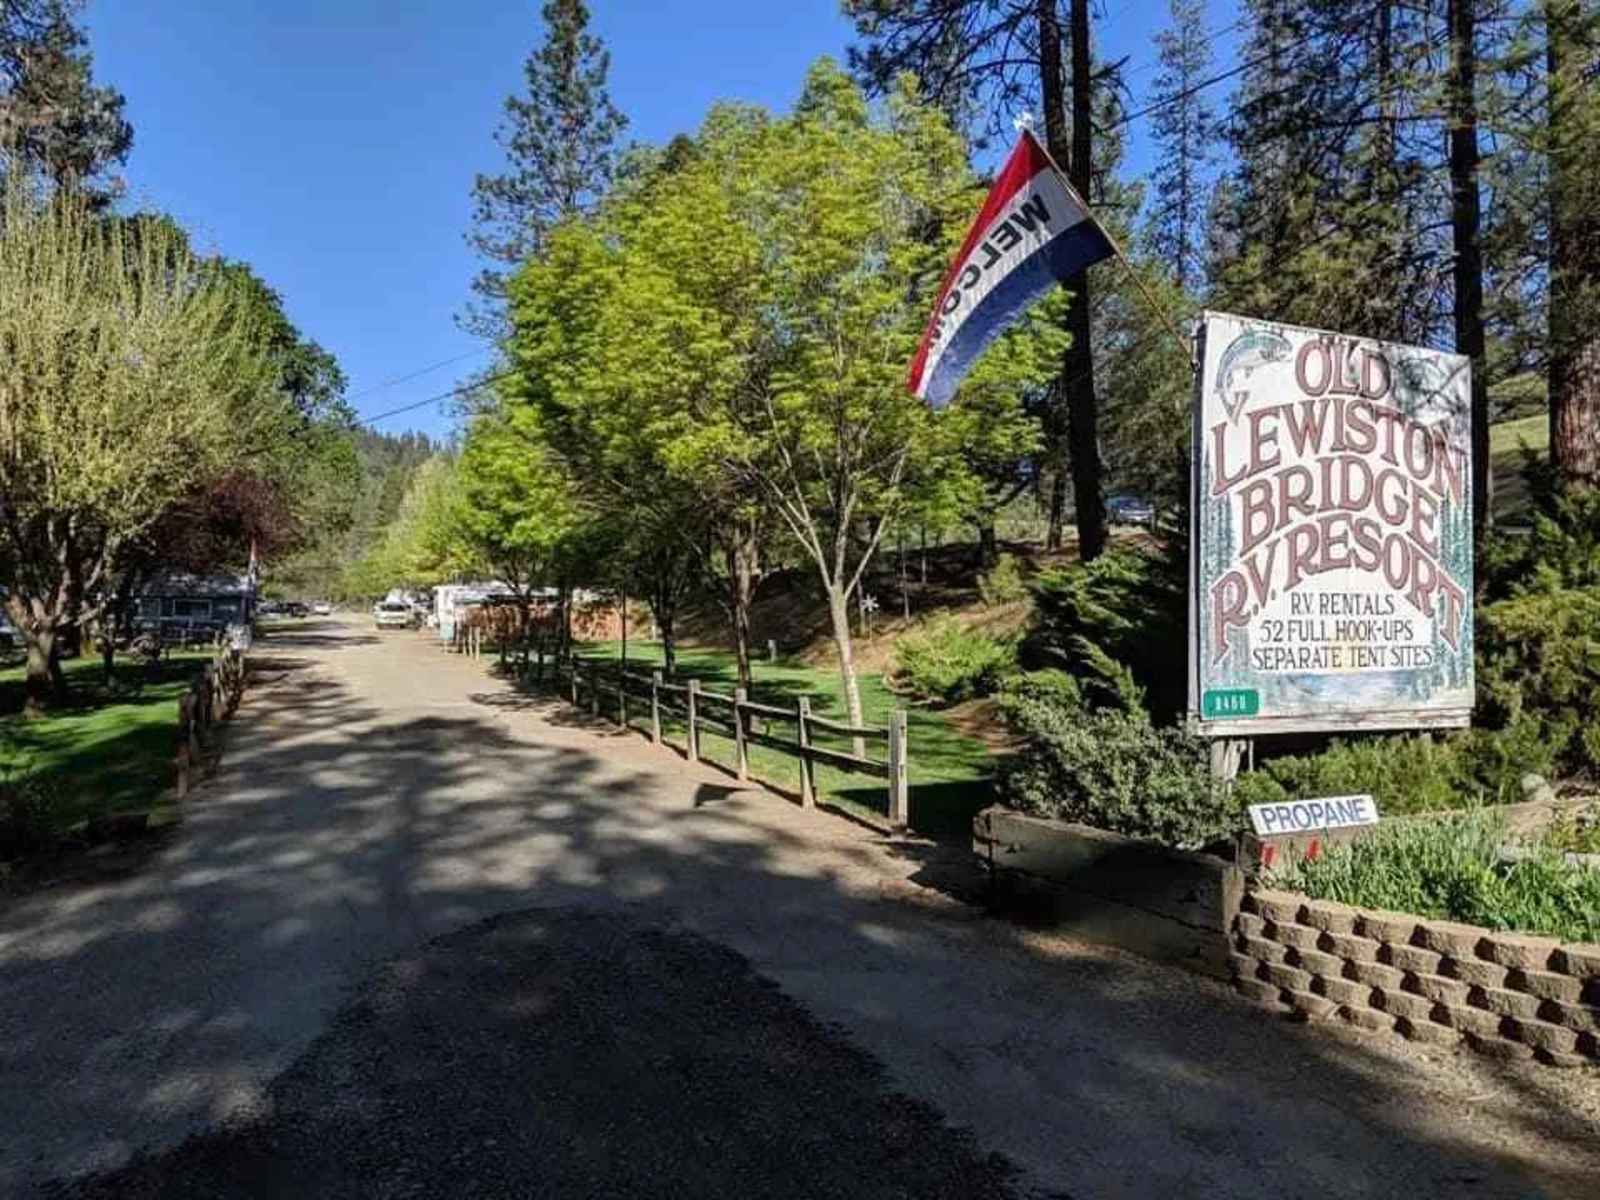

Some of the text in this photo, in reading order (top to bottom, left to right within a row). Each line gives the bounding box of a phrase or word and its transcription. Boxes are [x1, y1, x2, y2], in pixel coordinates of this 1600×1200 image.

[1295, 339, 1391, 400] OLD
[1211, 399, 1468, 504] LEWISTON
[1238, 454, 1439, 559] BRIDGE
[1211, 512, 1465, 666] R.V. RESORT
[1320, 592, 1395, 616] RENTALS
[1259, 618, 1414, 643] 52 FULL HOOK-UPS
[1253, 644, 1433, 670] SEPARATE TENT SITES
[1260, 799, 1370, 831] PROPANE
